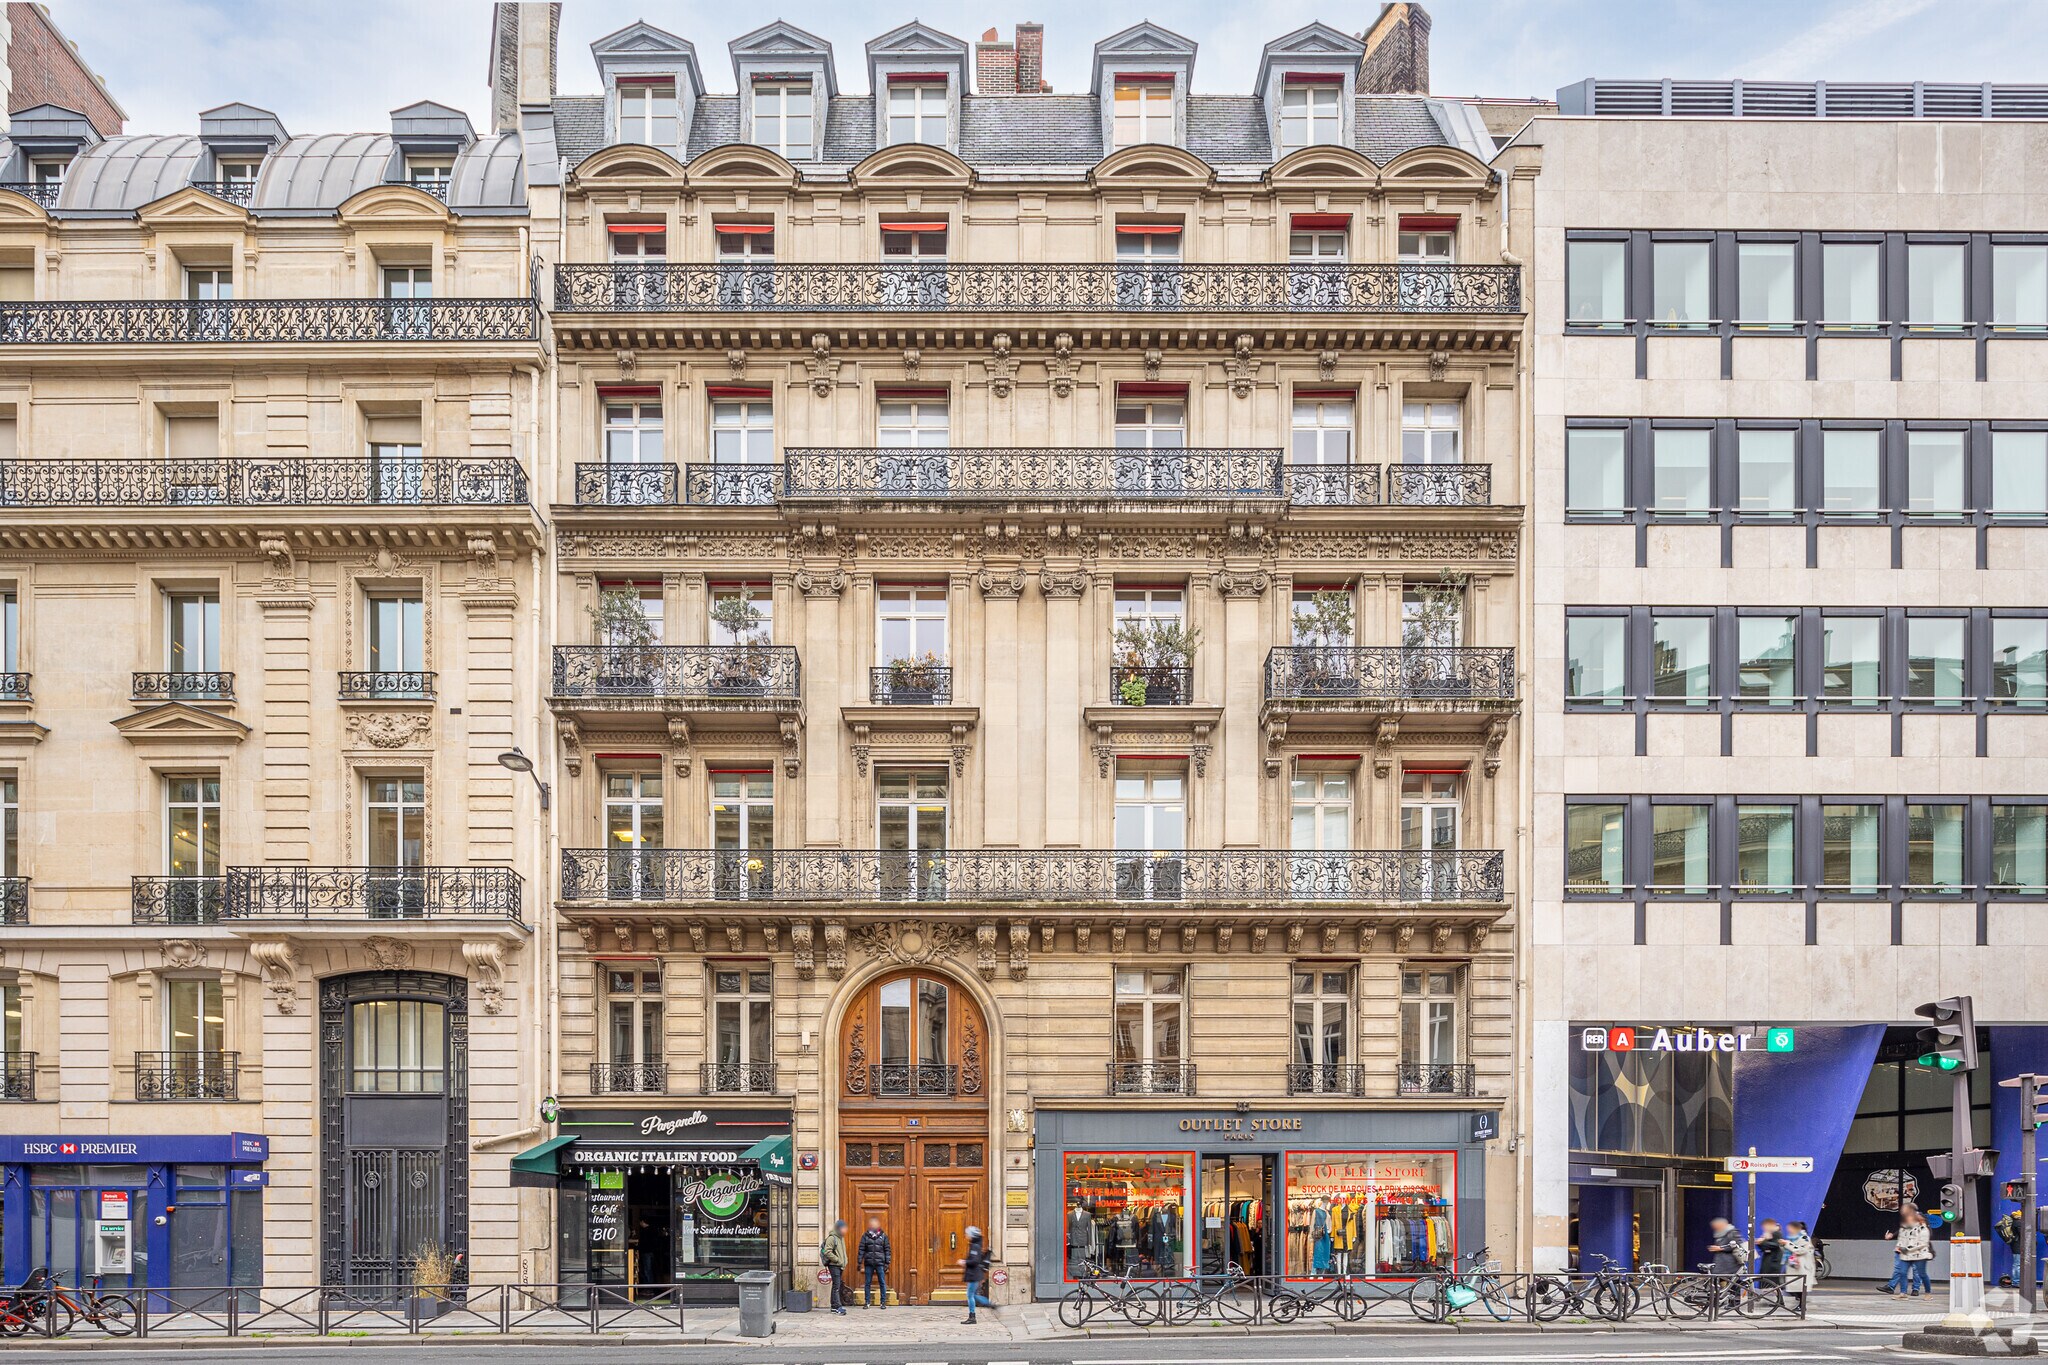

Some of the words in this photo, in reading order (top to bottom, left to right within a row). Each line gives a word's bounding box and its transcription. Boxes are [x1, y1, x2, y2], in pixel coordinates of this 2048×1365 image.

[1586, 1034, 1604, 1045] RER
[1616, 1032, 1629, 1046] A
[1652, 1028, 1751, 1051] Auber
[641, 1110, 708, 1135] Panzanella
[1179, 1118, 1243, 1131] OUTLET
[1250, 1118, 1302, 1131] STORE
[24, 1143, 58, 1154] HSBC
[81, 1143, 138, 1154] PREMIER
[574, 1151, 639, 1162] ORGANIC
[641, 1151, 697, 1162] ITALIEN
[700, 1151, 738, 1162] FOOD
[1385, 1166, 1427, 1177] STORE
[1095, 1188, 1103, 1196] DE
[1105, 1188, 1134, 1196] MARQUES
[1302, 1185, 1327, 1193] STOCK
[1329, 1185, 1338, 1193] DE
[1341, 1185, 1376, 1193] MARQUES
[1385, 1185, 1401, 1193] PRIX
[1404, 1185, 1440, 1193] DISCOUNT
[600, 1204, 617, 1214] Café
[593, 1215, 617, 1224] Italien
[592, 1227, 617, 1241] BIO
[700, 1225, 719, 1235] Santé
[720, 1225, 733, 1237] dans
